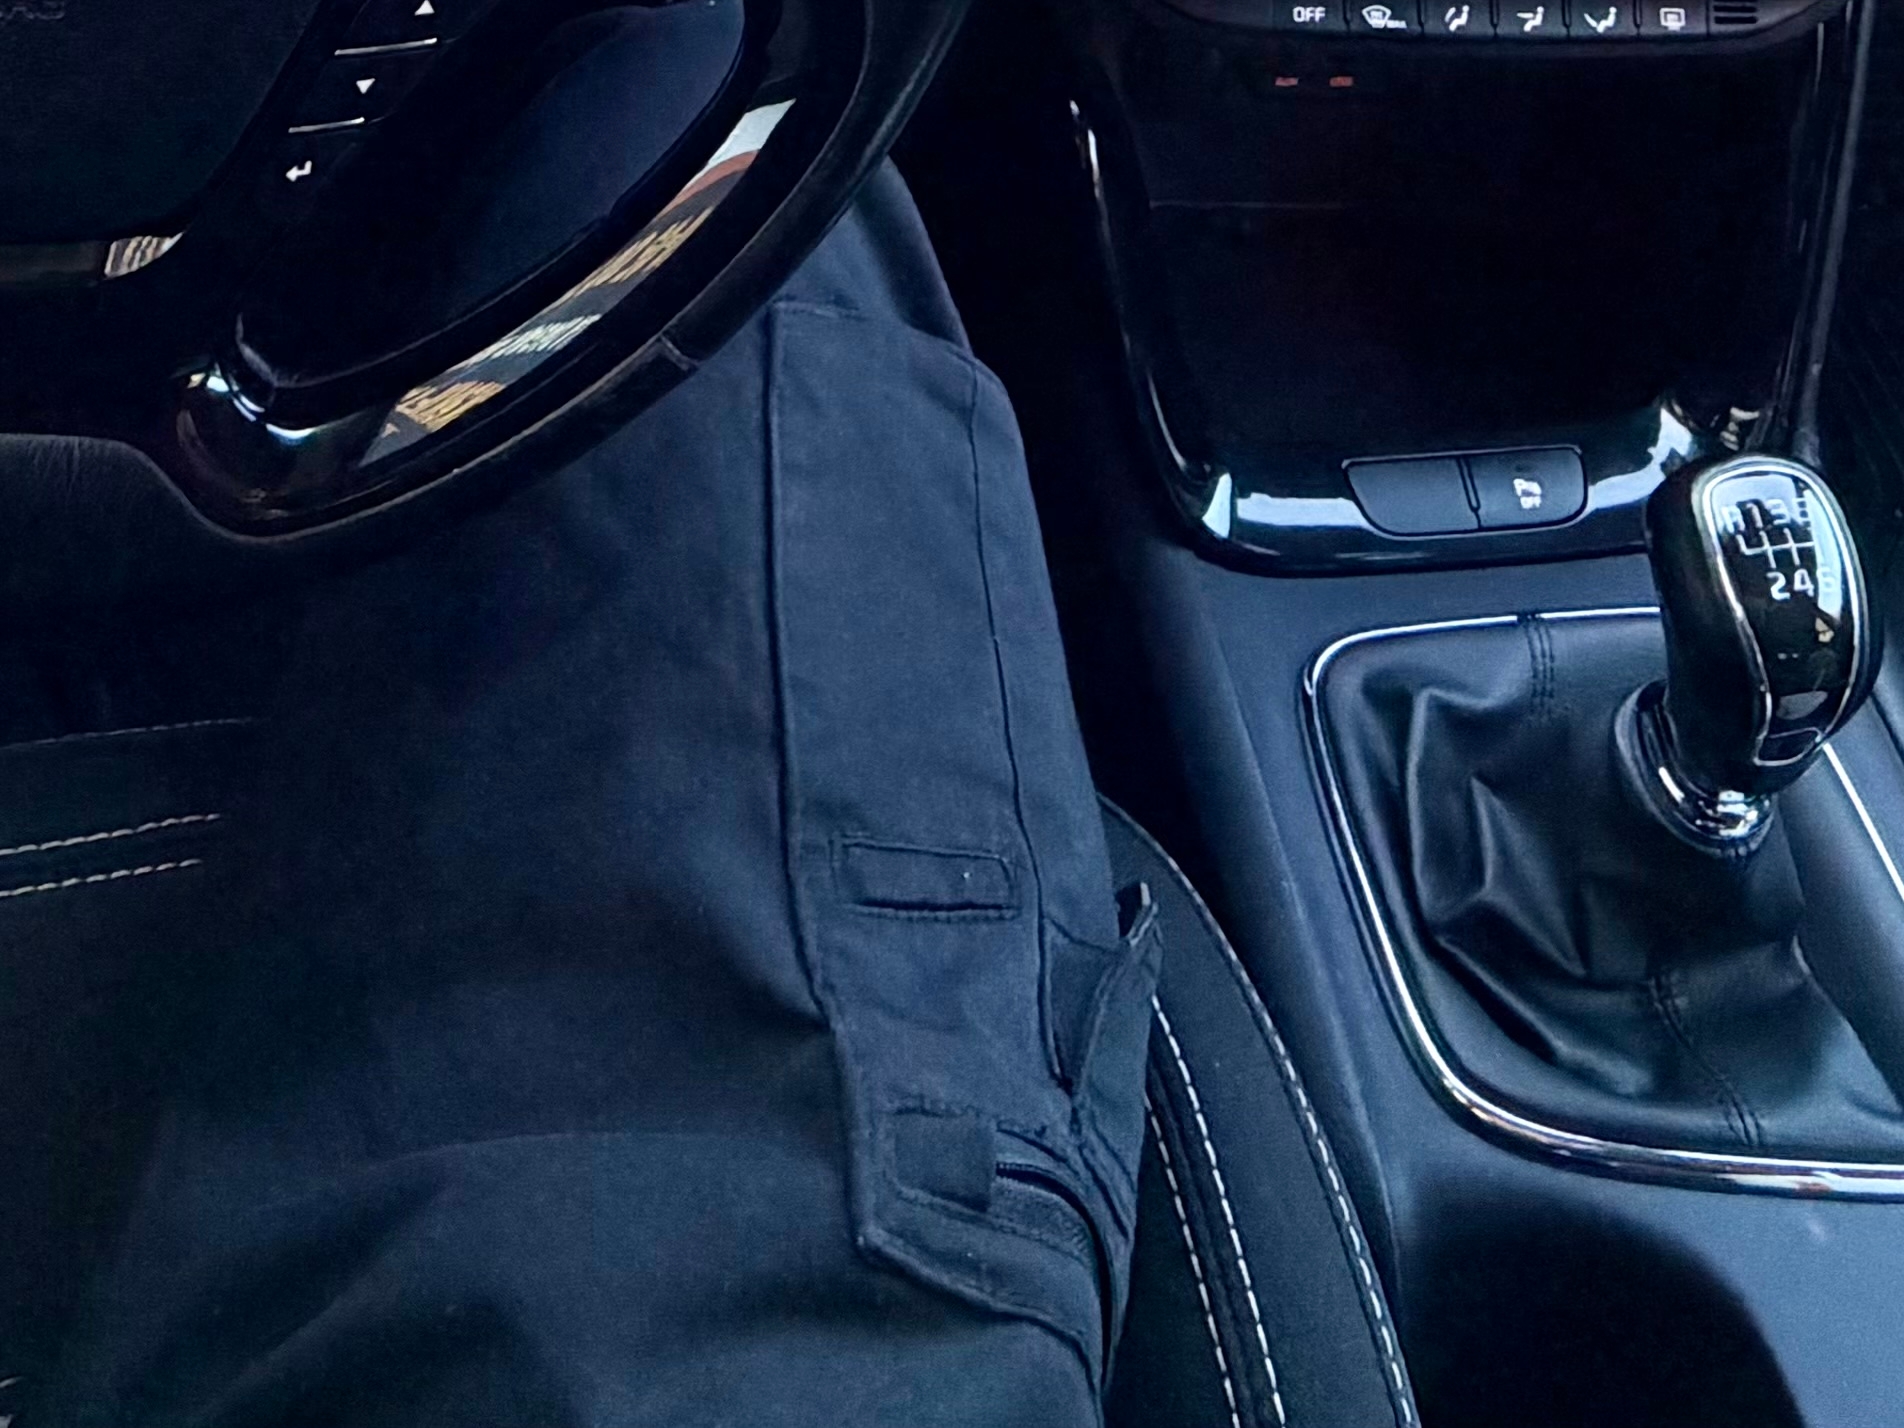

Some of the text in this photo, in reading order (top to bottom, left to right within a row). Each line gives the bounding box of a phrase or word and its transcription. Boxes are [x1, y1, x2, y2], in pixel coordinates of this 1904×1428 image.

[1292, 5, 1326, 23] OFF
[1745, 503, 1764, 528] 1
[1765, 498, 1791, 525] 3
[1766, 571, 1791, 600] 2
[1793, 568, 1815, 598] 4
